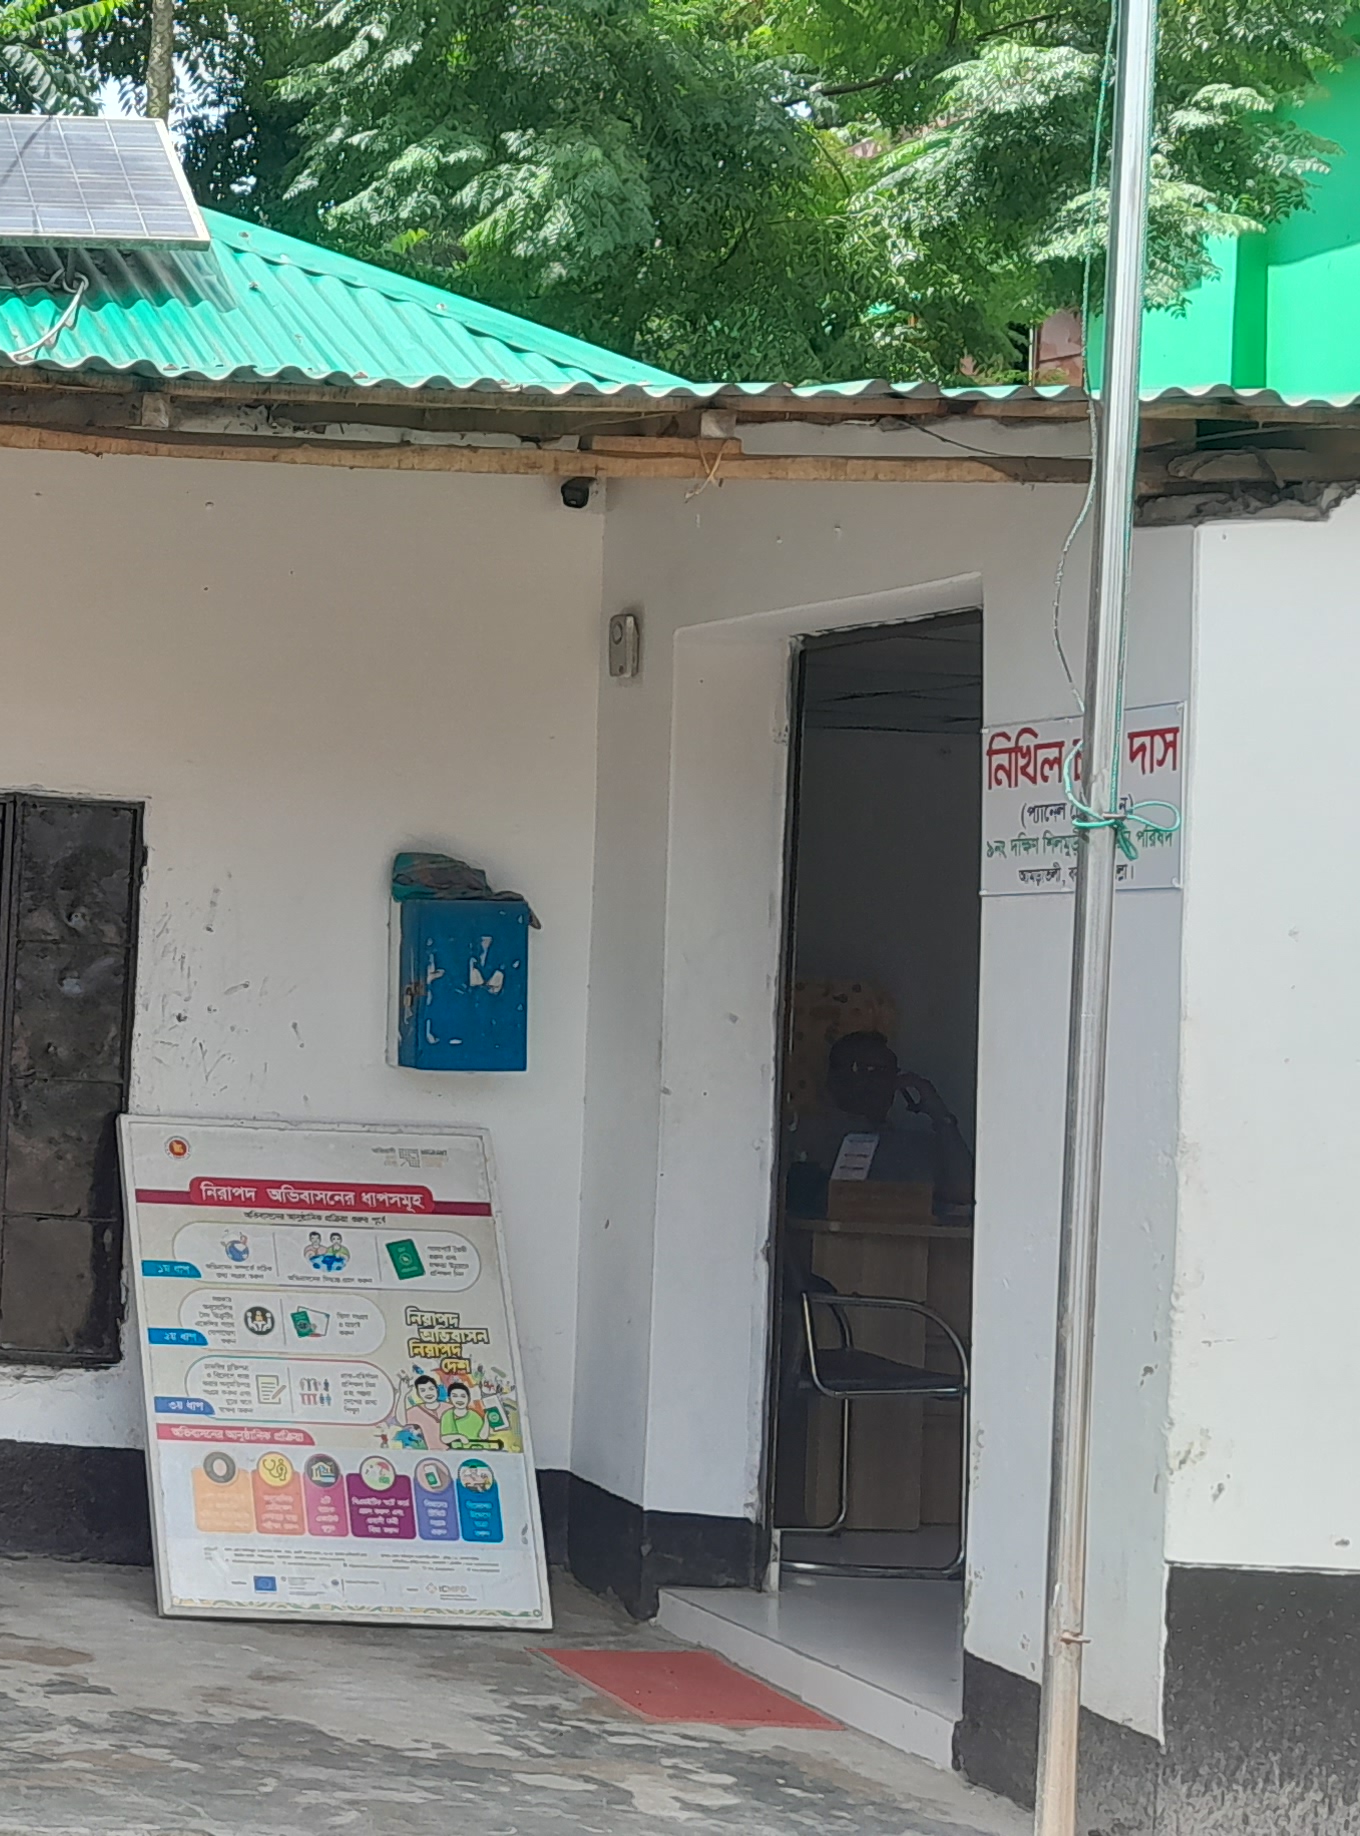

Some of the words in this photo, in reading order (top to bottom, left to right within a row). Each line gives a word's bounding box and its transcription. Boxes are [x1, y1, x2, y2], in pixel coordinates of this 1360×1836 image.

[986, 728, 1065, 790] নিখিল
[1128, 727, 1179, 774] দাস
[200, 1181, 257, 1202] নিরাপদ
[266, 1185, 356, 1207] অভিবাসনের
[361, 1191, 425, 1213] ধাপসমূহ
[405, 1306, 460, 1328] নিরাপদ
[417, 1327, 490, 1344] অভিবাসন
[407, 1337, 462, 1358] নিরাপদ
